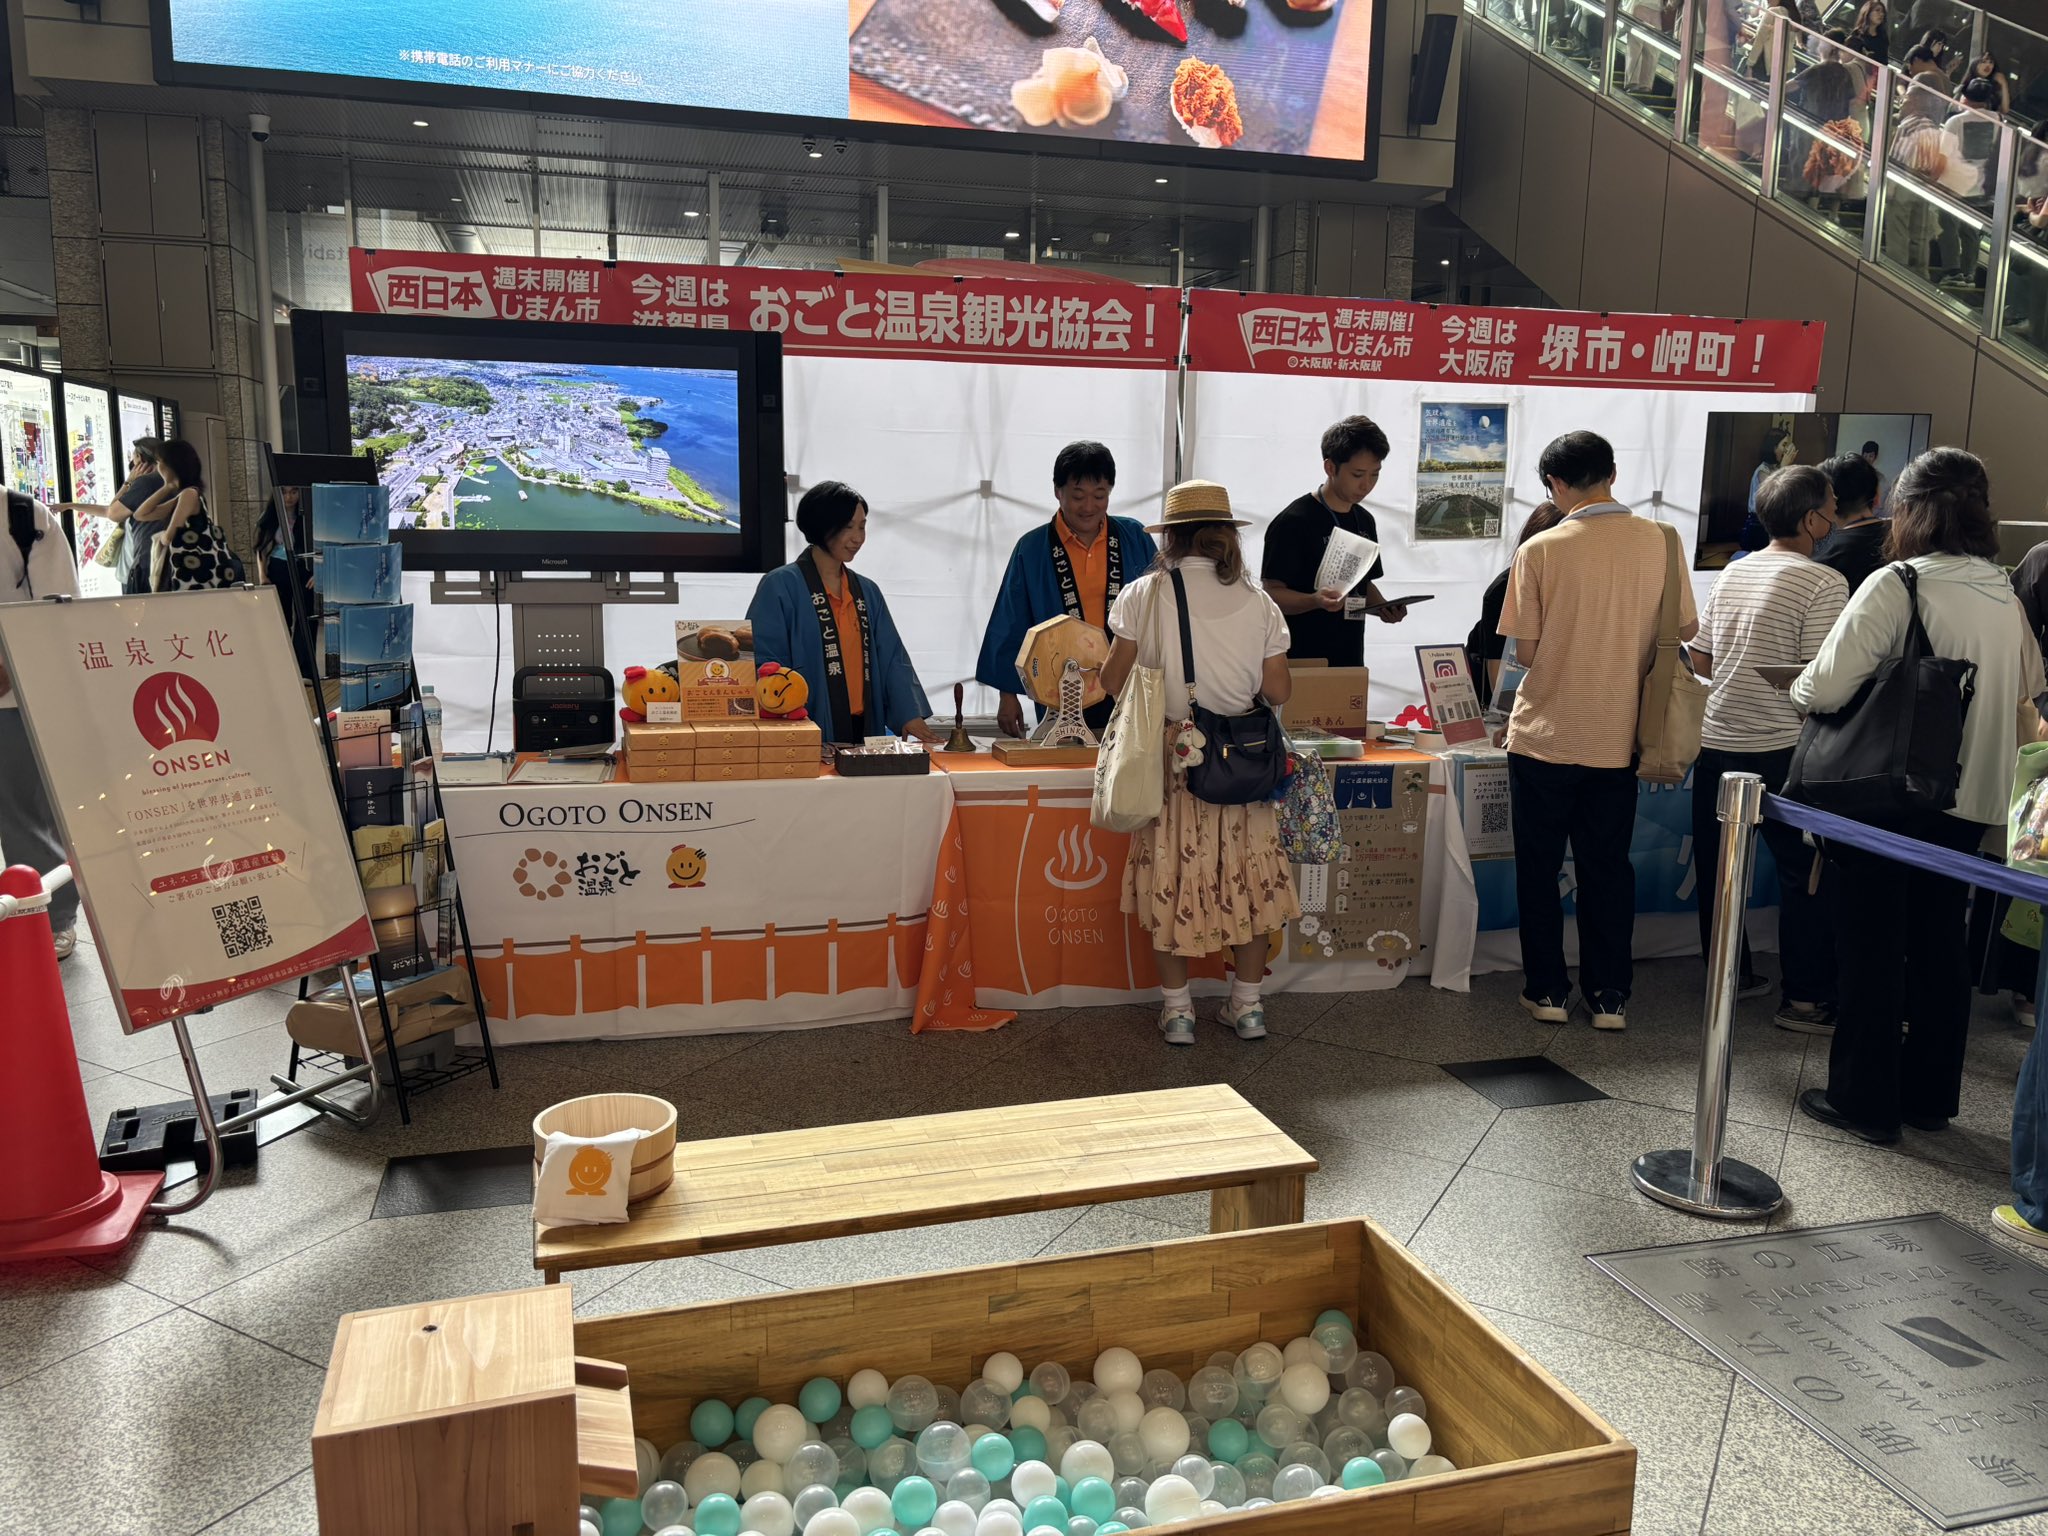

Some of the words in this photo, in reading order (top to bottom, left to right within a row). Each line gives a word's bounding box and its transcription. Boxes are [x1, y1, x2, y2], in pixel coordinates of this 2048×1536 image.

[388, 274, 482, 312] 西日本
[493, 265, 600, 294] 週末開催!
[631, 272, 729, 308] 今週は
[501, 294, 601, 322] じまん市
[749, 285, 1156, 352] おごと温泉観光協会！
[1332, 307, 1415, 333] 週末開催!
[1252, 314, 1331, 351] 西日本
[1336, 331, 1413, 358] じまん市
[1441, 315, 1518, 345] 今週は
[1438, 348, 1512, 378] 大阪府
[1539, 322, 1764, 378] 堺市・岬町！
[811, 591, 843, 676] おごと温泉
[78, 629, 234, 671] 温泉文化
[1055, 727, 1087, 738] SHINKO
[153, 749, 232, 777] ONSEN
[499, 801, 608, 827] OGOTO
[618, 798, 715, 825] ONSEN
[574, 850, 643, 886] おごと
[578, 878, 617, 898] 温泉
[1044, 904, 1098, 924] OGOTO
[1047, 927, 1105, 946] ONSEN
[1681, 1231, 1925, 1281] 暁の広場
[1768, 1271, 1886, 1303] AKATSUKI
